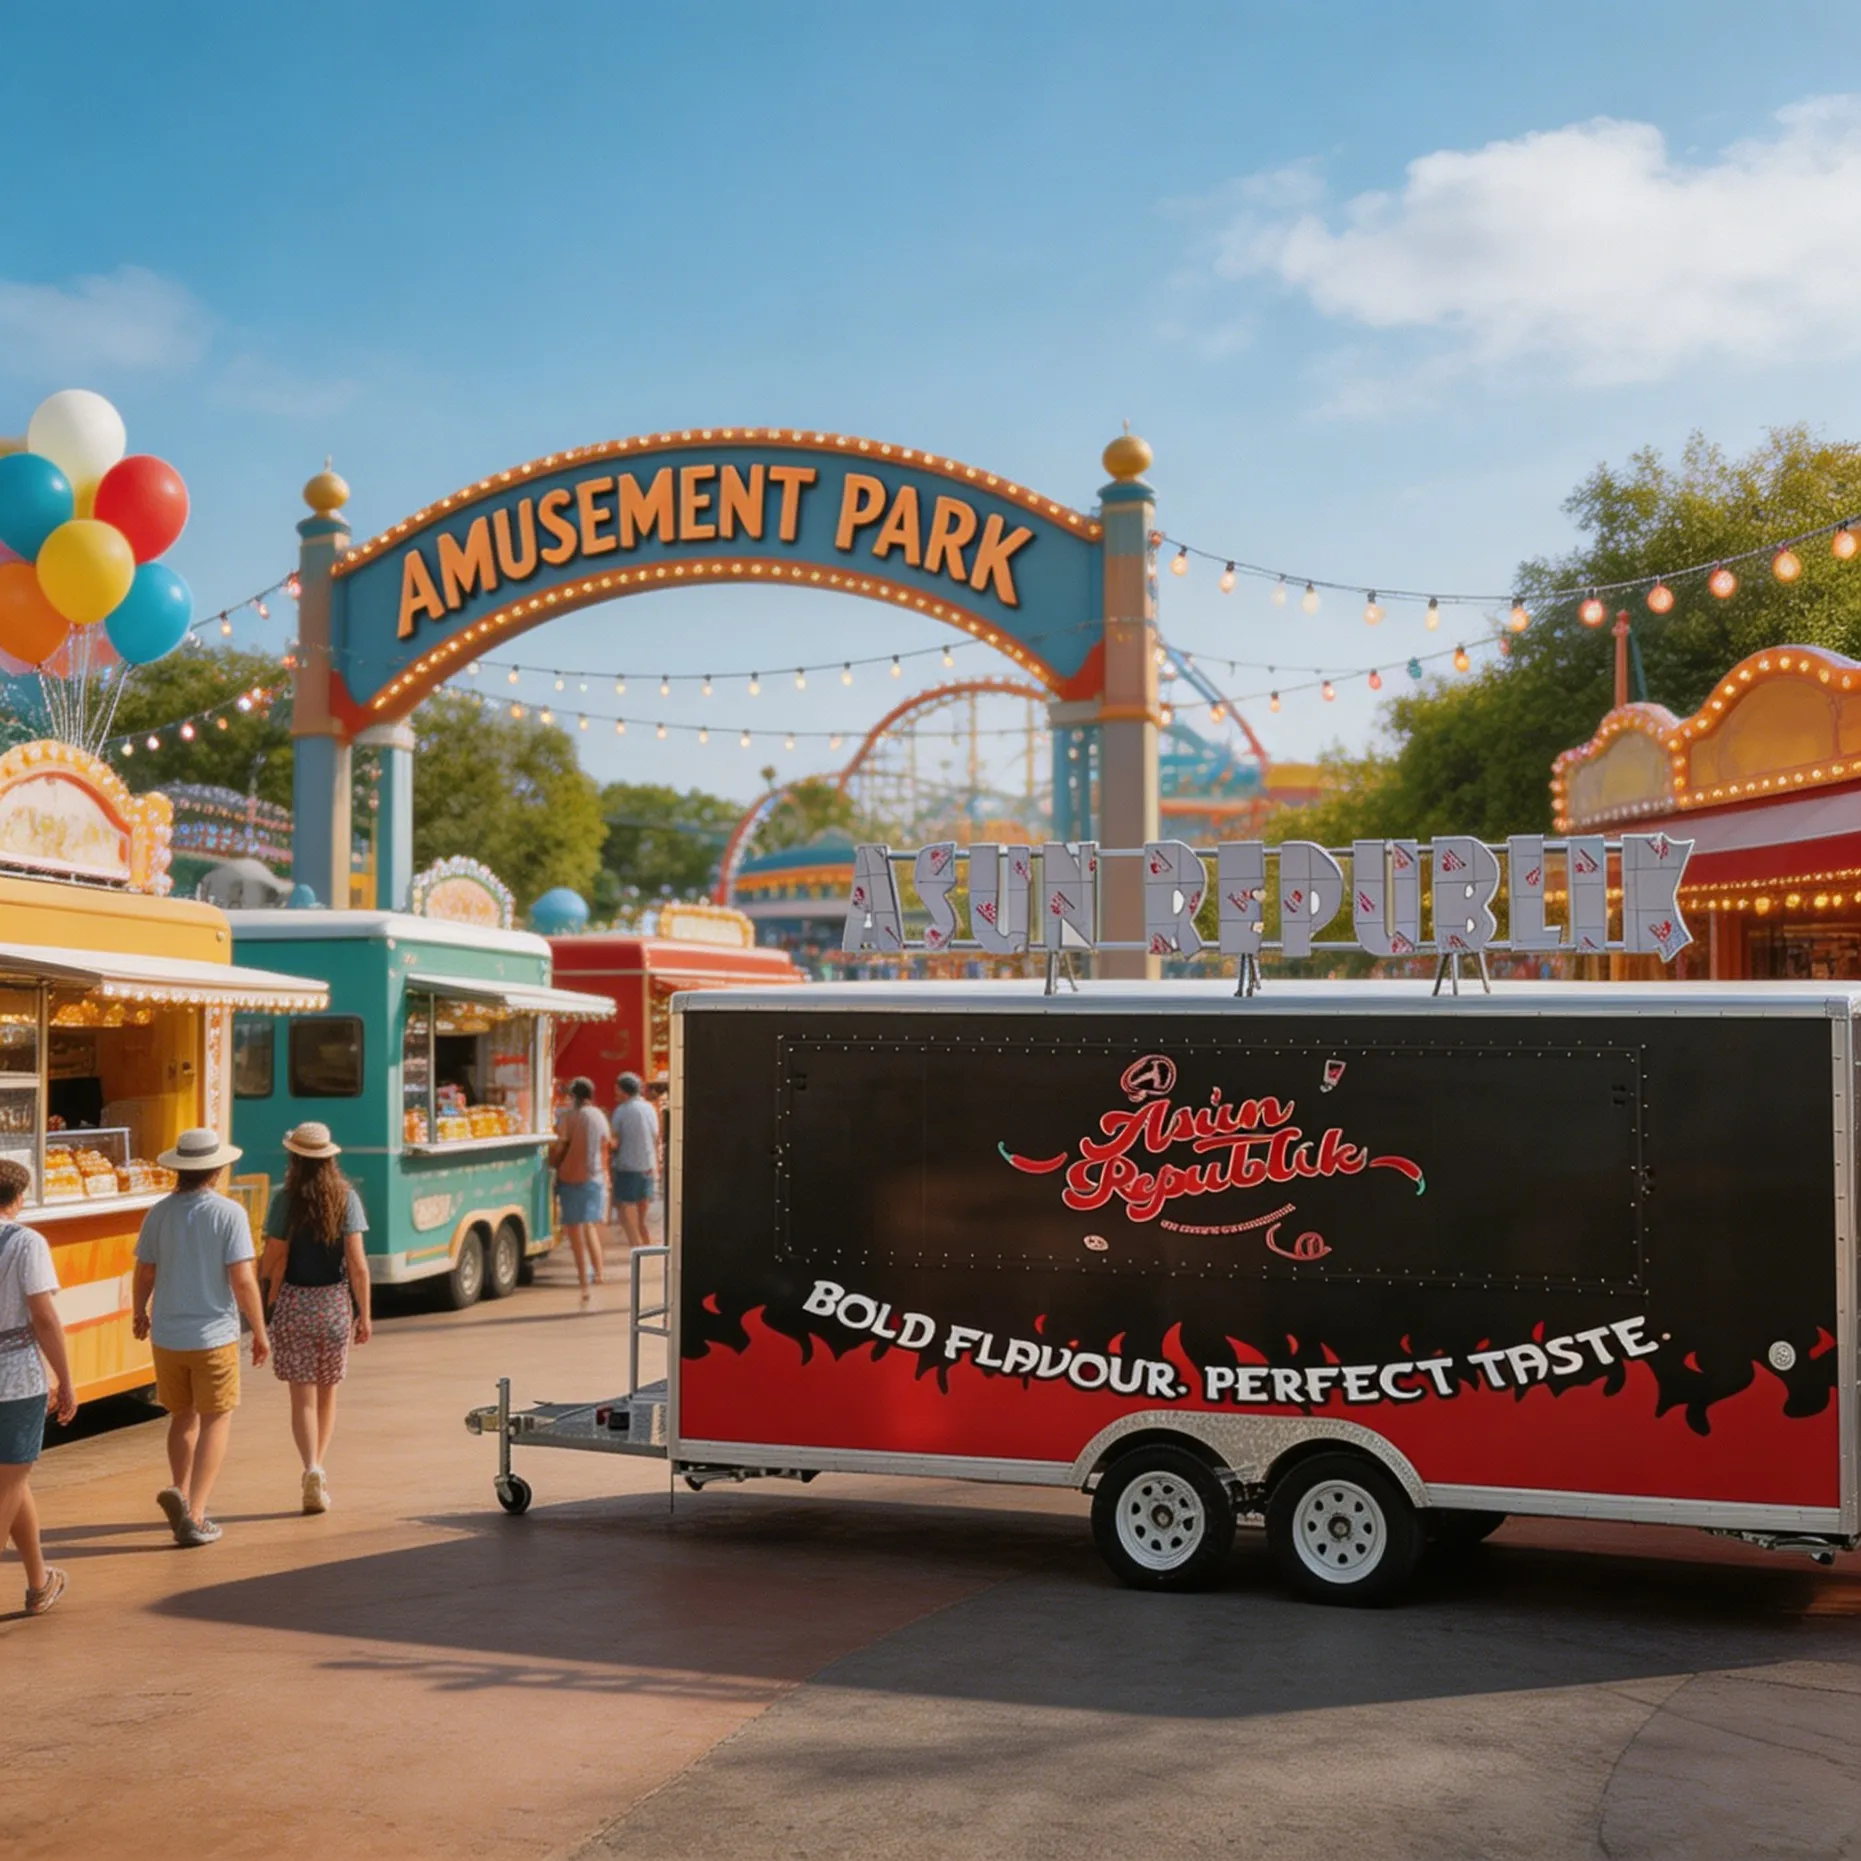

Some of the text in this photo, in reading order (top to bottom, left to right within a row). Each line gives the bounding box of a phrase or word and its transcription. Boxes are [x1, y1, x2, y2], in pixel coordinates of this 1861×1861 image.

[397, 463, 1034, 637] AMUSEMENT PARK
[842, 840, 1099, 953] ASUN
[802, 1280, 936, 1349] BOLD
[943, 1324, 1189, 1398] FLAVOUR.
[1204, 1356, 1454, 1403] PERFECT
